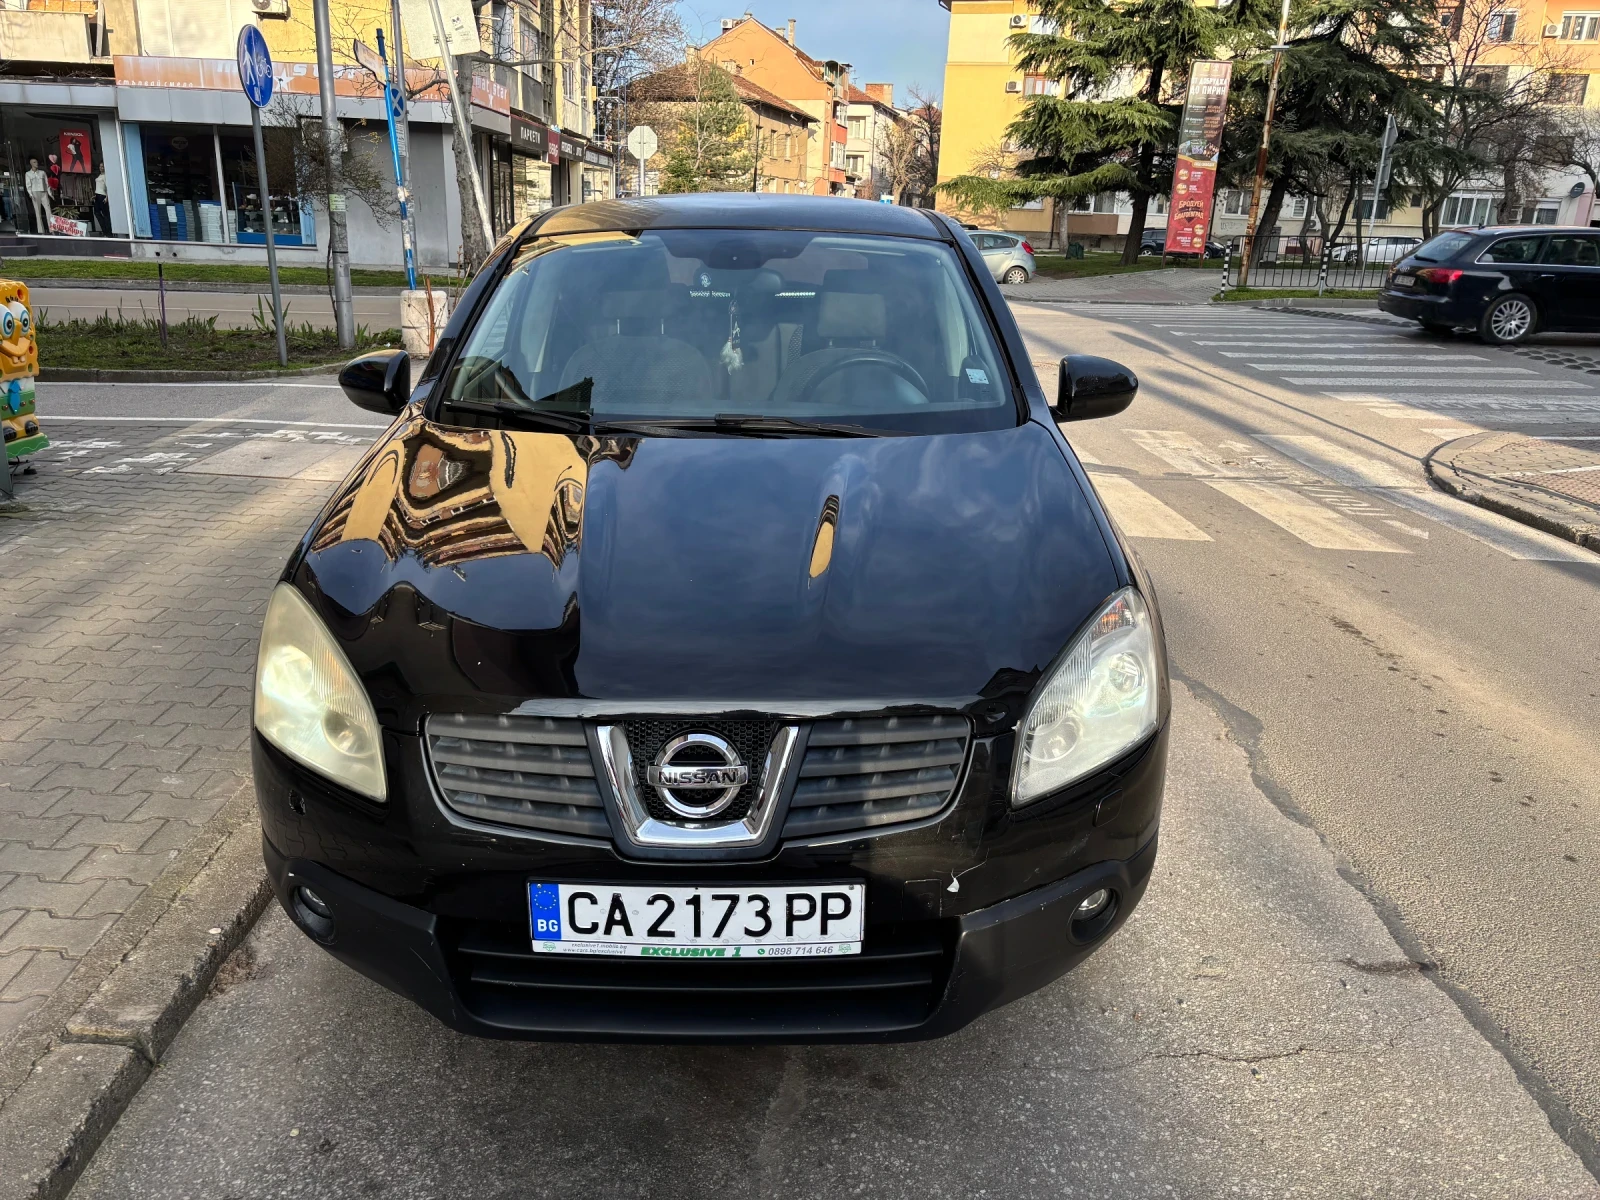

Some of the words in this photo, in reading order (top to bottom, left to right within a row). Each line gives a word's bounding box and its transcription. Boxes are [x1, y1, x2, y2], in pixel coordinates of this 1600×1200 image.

[492, 83, 507, 100] star
[1201, 85, 1226, 95] ПИРИН
[520, 126, 541, 144] ПАРКЕТИ
[658, 771, 738, 784] NISSAN
[567, 891, 634, 937] CA
[646, 893, 772, 938] 2173
[785, 892, 852, 937] PP
[537, 919, 559, 932] BG
[641, 946, 727, 957] EXCLUSIVE
[732, 946, 741, 957] 1
[768, 947, 792, 956] 0898
[796, 947, 812, 955] 714
[815, 946, 833, 954] 646
